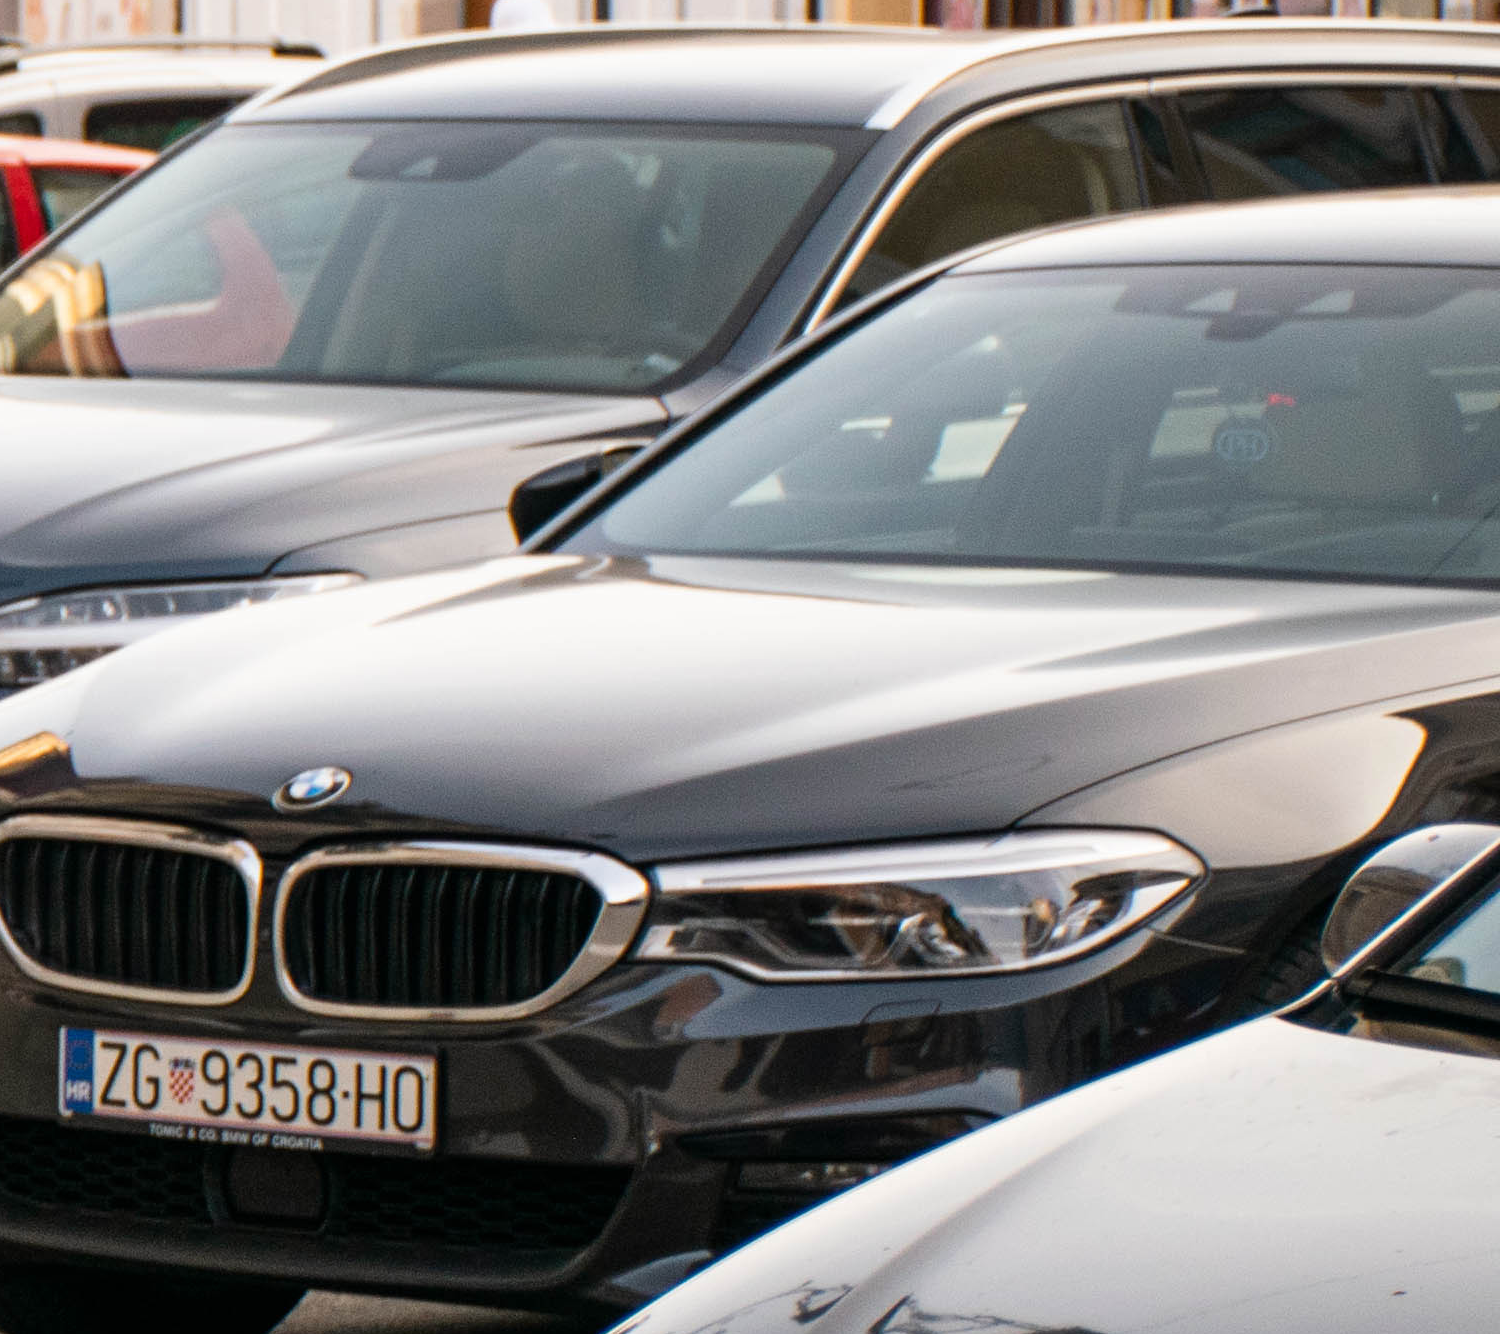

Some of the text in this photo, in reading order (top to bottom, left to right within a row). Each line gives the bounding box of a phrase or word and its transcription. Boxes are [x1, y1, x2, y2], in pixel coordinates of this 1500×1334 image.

[101, 1042, 161, 1110] ZG
[66, 1079, 92, 1101] HR
[221, 1130, 250, 1145] BMW
[252, 1133, 270, 1146] OF
[271, 1134, 324, 1151] CROATIA
